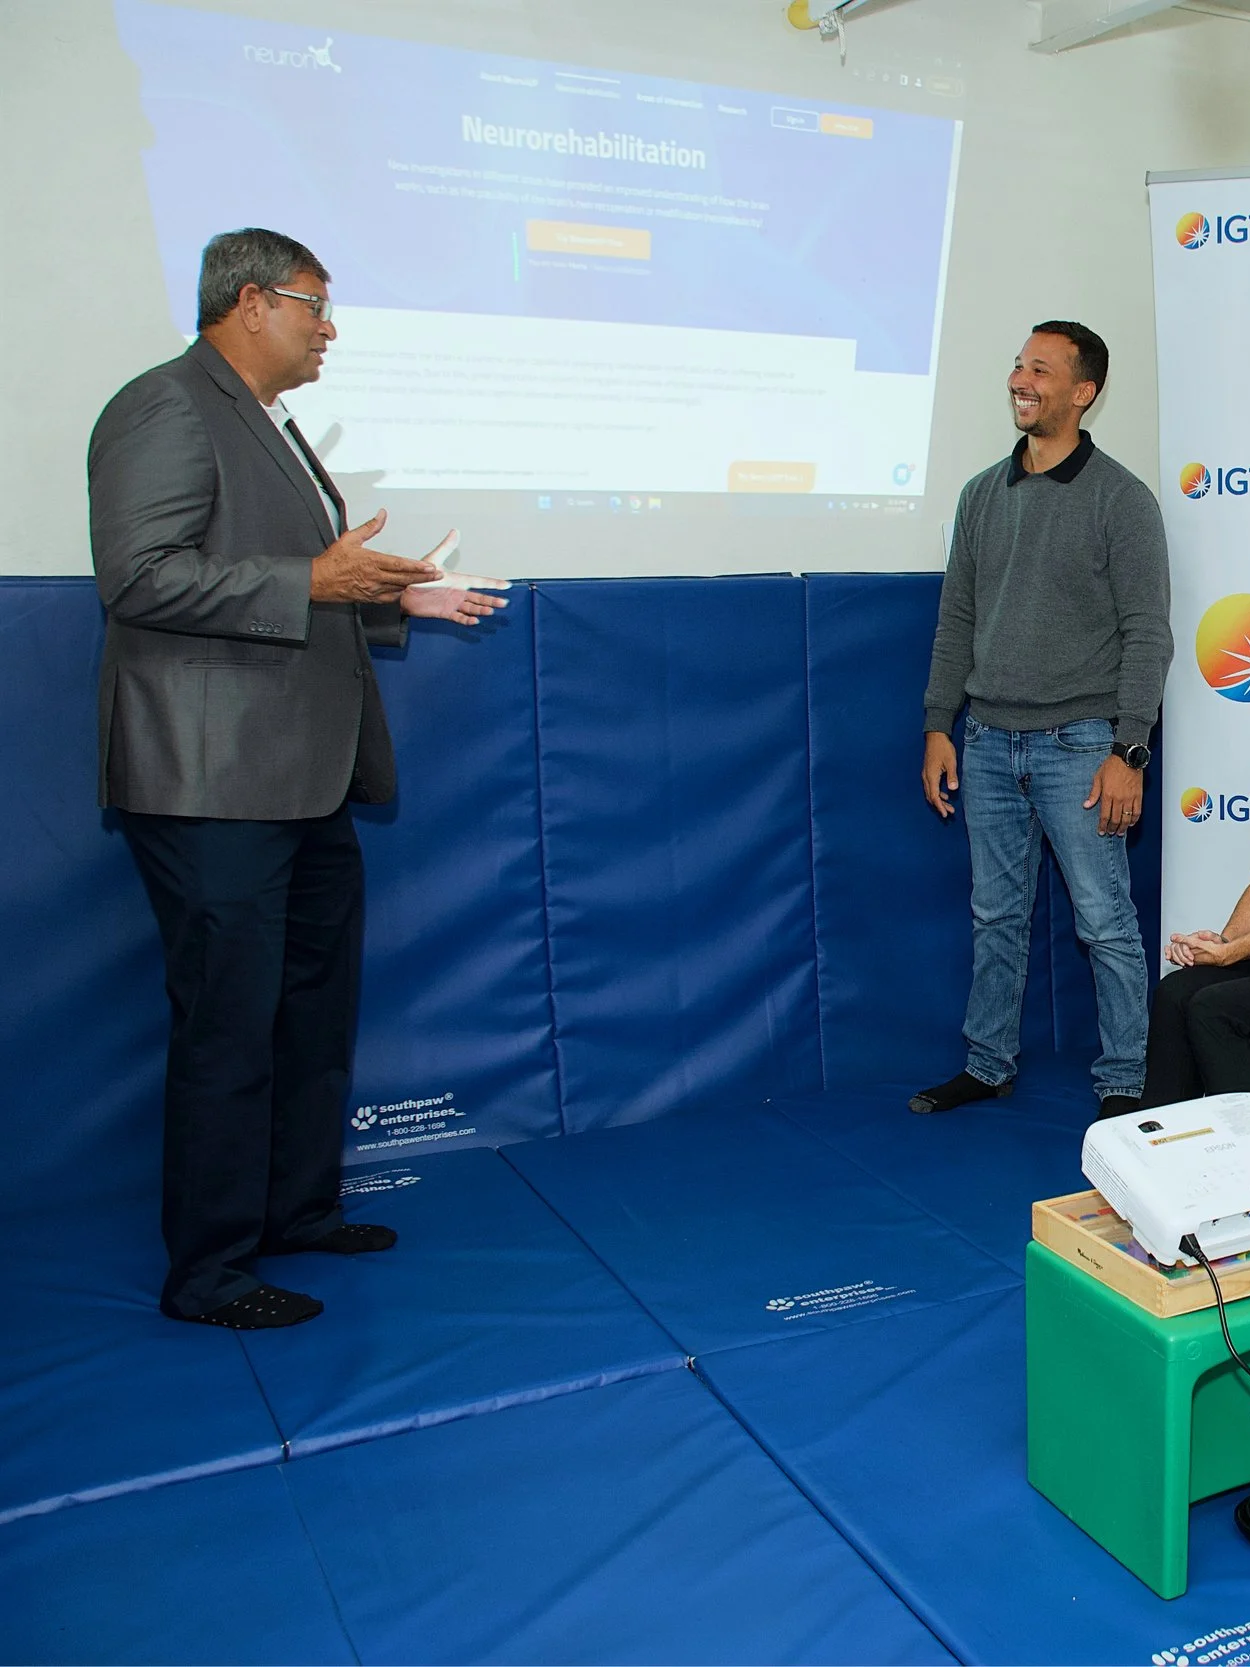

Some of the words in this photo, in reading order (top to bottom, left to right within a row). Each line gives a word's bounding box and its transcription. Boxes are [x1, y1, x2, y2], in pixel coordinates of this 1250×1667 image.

[461, 114, 706, 171] Neurorehabilitation
[379, 1107, 456, 1126] enterprises
[357, 1126, 477, 1152] www.southpawenterprises.com
[386, 1121, 446, 1136] 1-800-228-1698
[799, 1286, 884, 1307] enterprises
